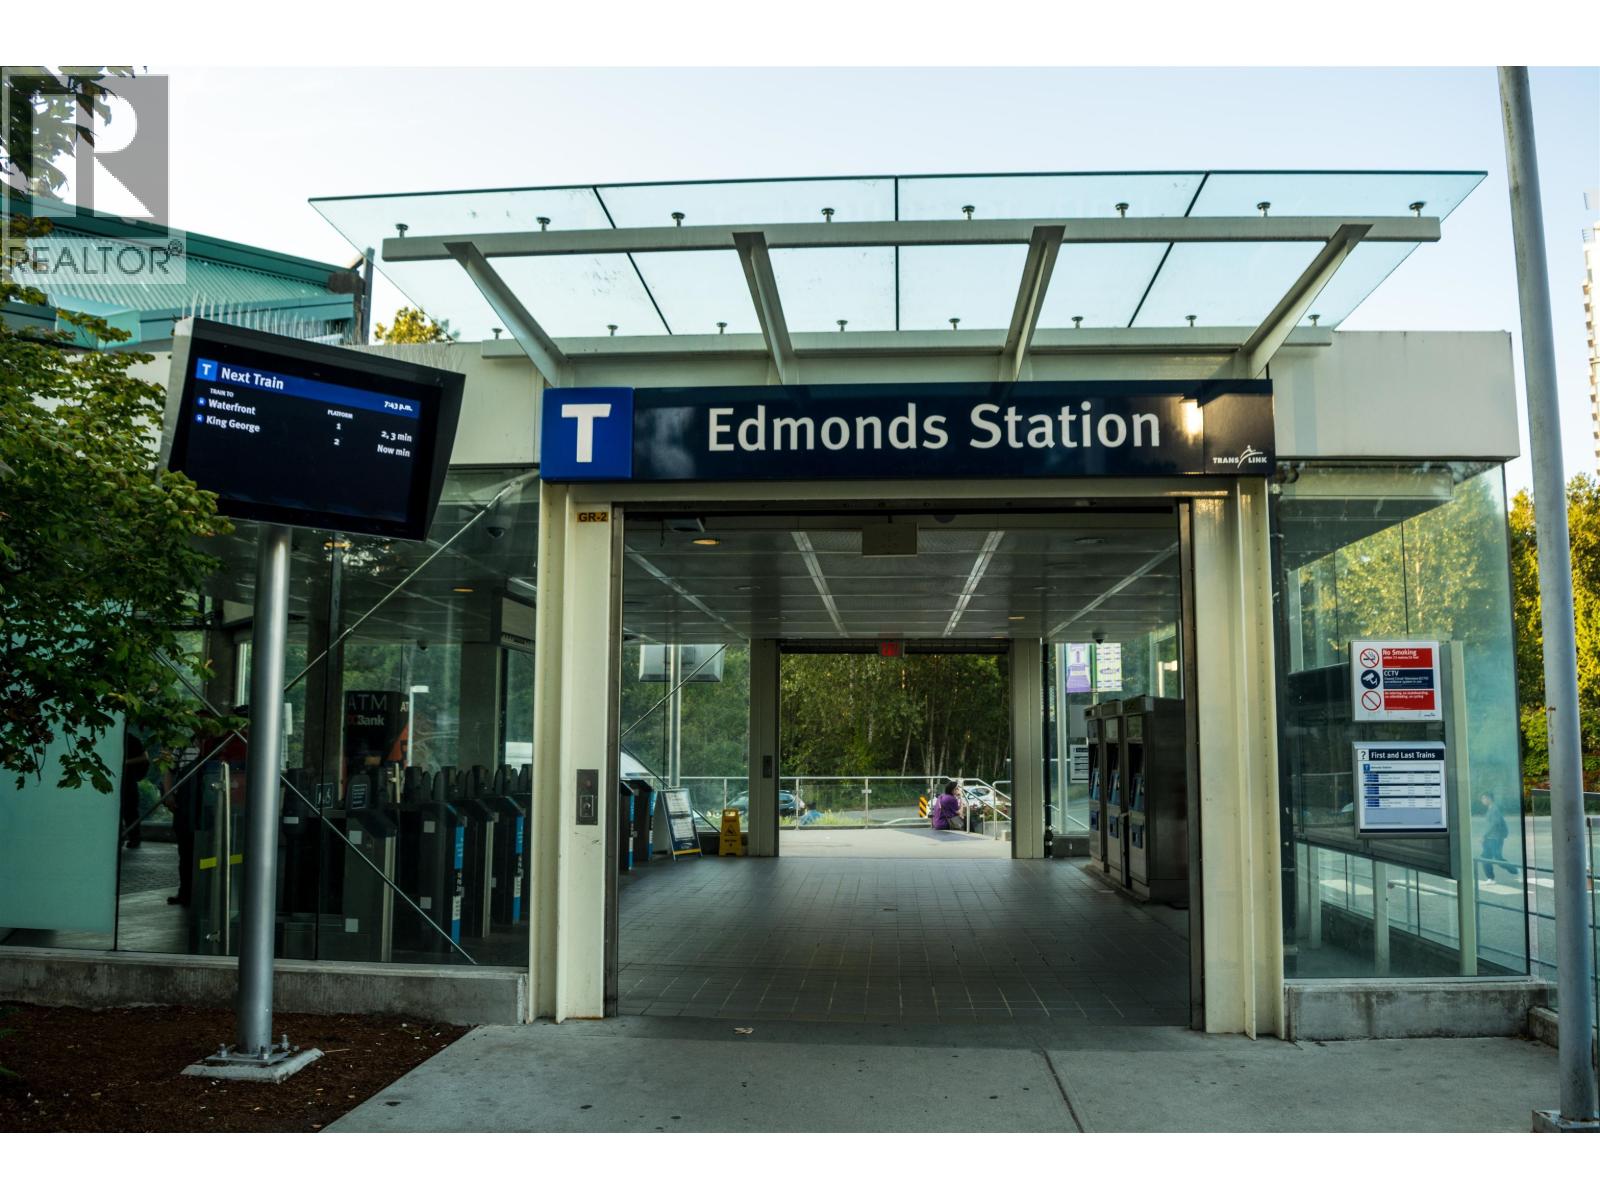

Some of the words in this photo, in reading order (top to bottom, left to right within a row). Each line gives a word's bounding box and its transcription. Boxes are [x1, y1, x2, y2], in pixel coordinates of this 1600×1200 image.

[202, 363, 212, 376] T
[221, 367, 251, 384] Next
[253, 373, 284, 390] Train
[209, 388, 226, 396] TRAIN
[226, 390, 235, 398] TO
[208, 398, 256, 415] Waterfront
[206, 415, 228, 429] King
[228, 419, 261, 433] George
[708, 402, 949, 452] Edmonds
[969, 400, 1160, 449] Station
[390, 432, 397, 441] 3
[397, 433, 412, 442] min
[561, 403, 612, 463] T
[333, 438, 340, 446] 2
[377, 444, 394, 455] Now
[395, 447, 411, 458] min
[1248, 456, 1267, 464] LINK
[578, 512, 608, 522] GR-2
[1392, 648, 1417, 657] Smoking
[349, 694, 388, 711] ATM
[1371, 751, 1386, 759] First
[1387, 751, 1400, 759] and
[1401, 751, 1415, 759] Last
[1416, 751, 1436, 759] Trains
